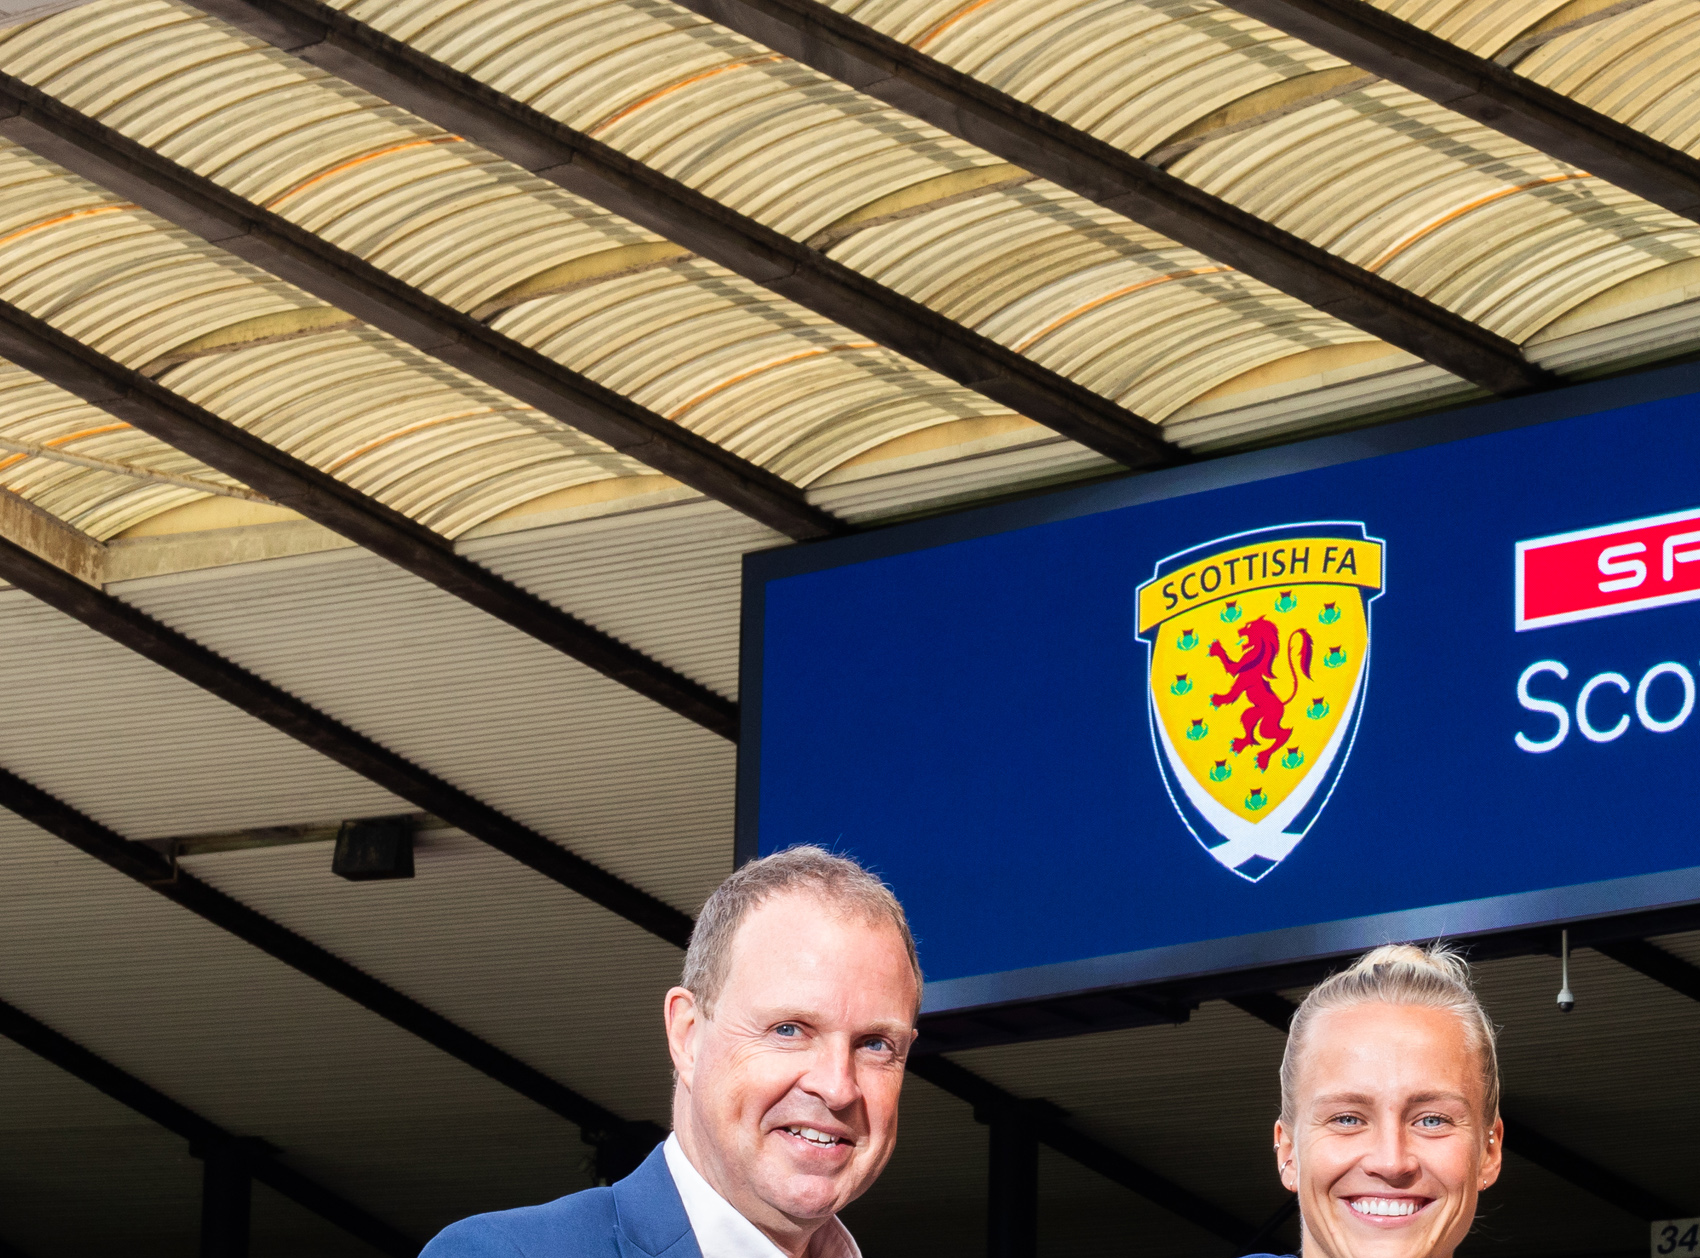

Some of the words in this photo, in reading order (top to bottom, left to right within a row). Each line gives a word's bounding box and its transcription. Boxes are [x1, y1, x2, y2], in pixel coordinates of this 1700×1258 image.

[1161, 546, 1311, 612] SCOTTISH
[1322, 546, 1360, 579] FA
[1656, 1223, 1700, 1256] 34
